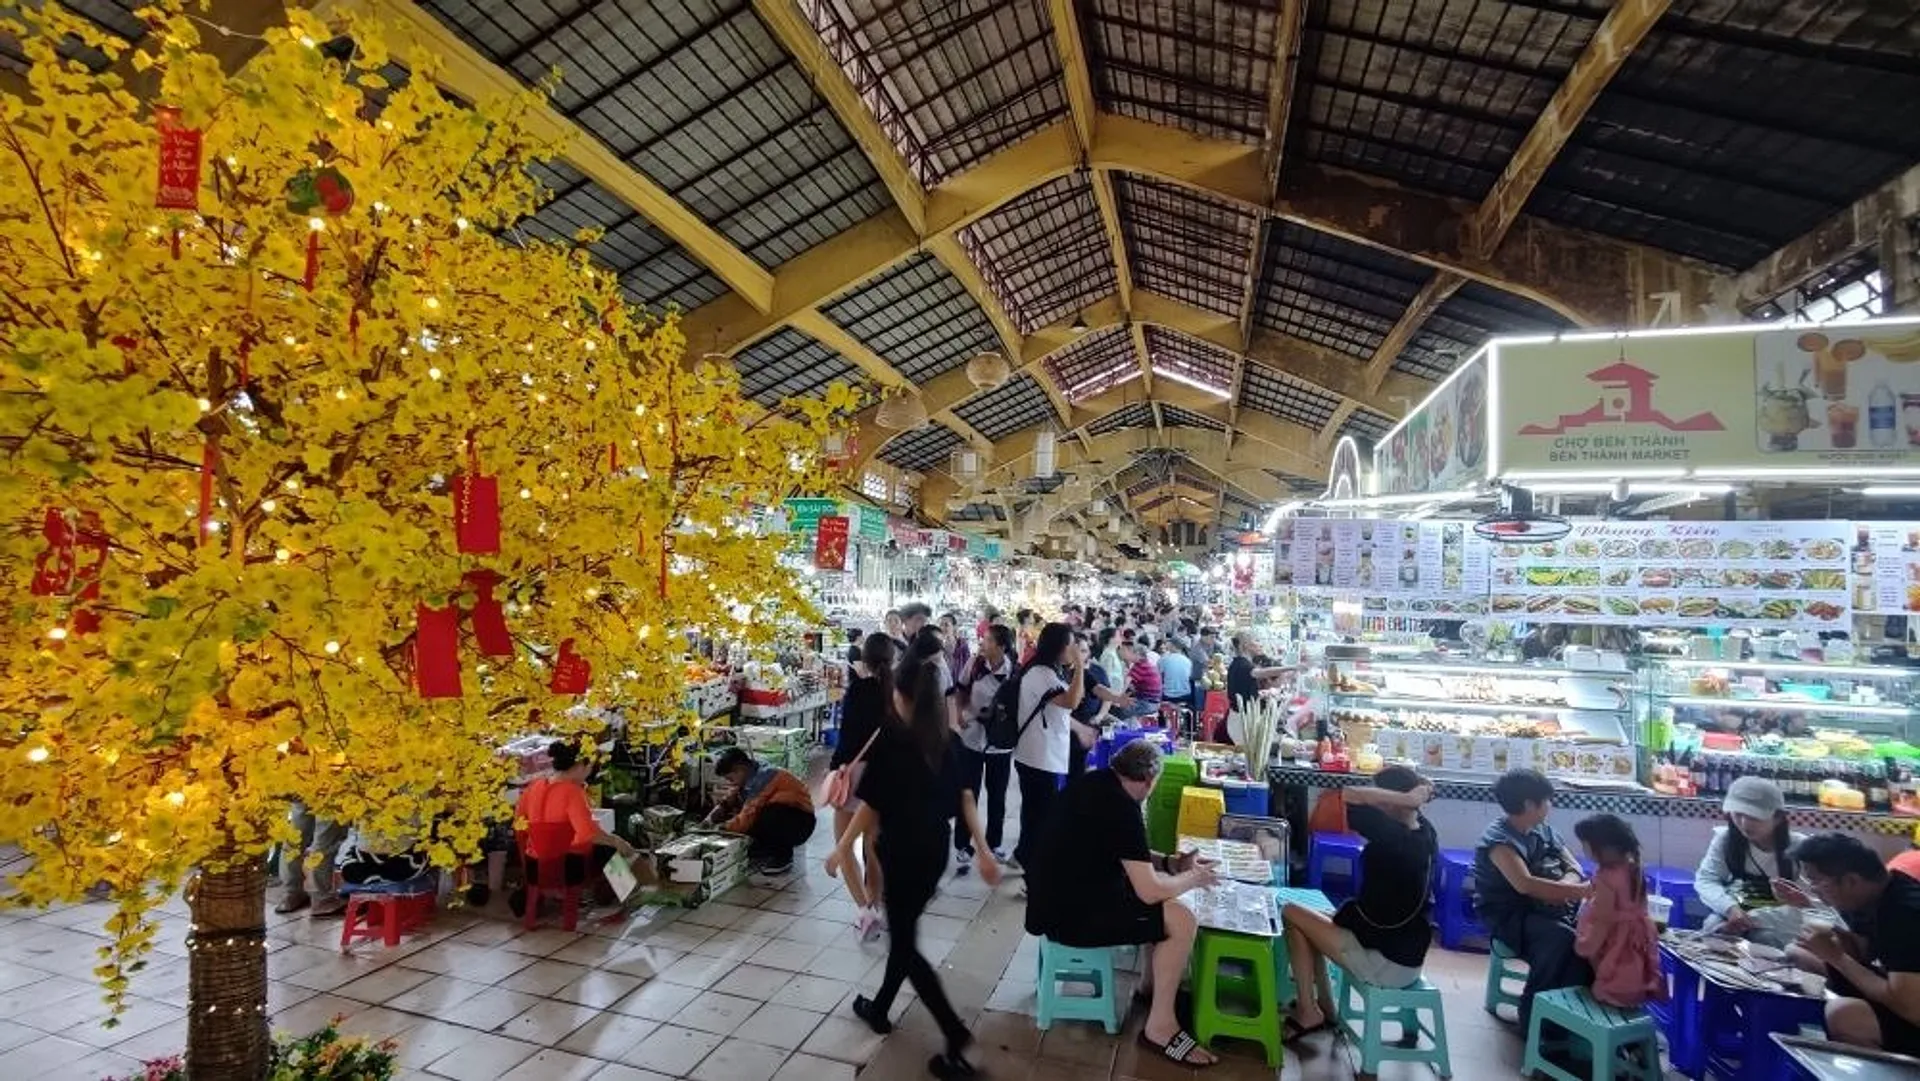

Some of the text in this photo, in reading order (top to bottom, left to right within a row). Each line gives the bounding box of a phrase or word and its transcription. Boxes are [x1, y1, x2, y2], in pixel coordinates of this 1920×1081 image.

[1554, 436, 1589, 449] CHỢ
[1628, 432, 1685, 446] THÀNH
[1632, 449, 1690, 461] MARKET
